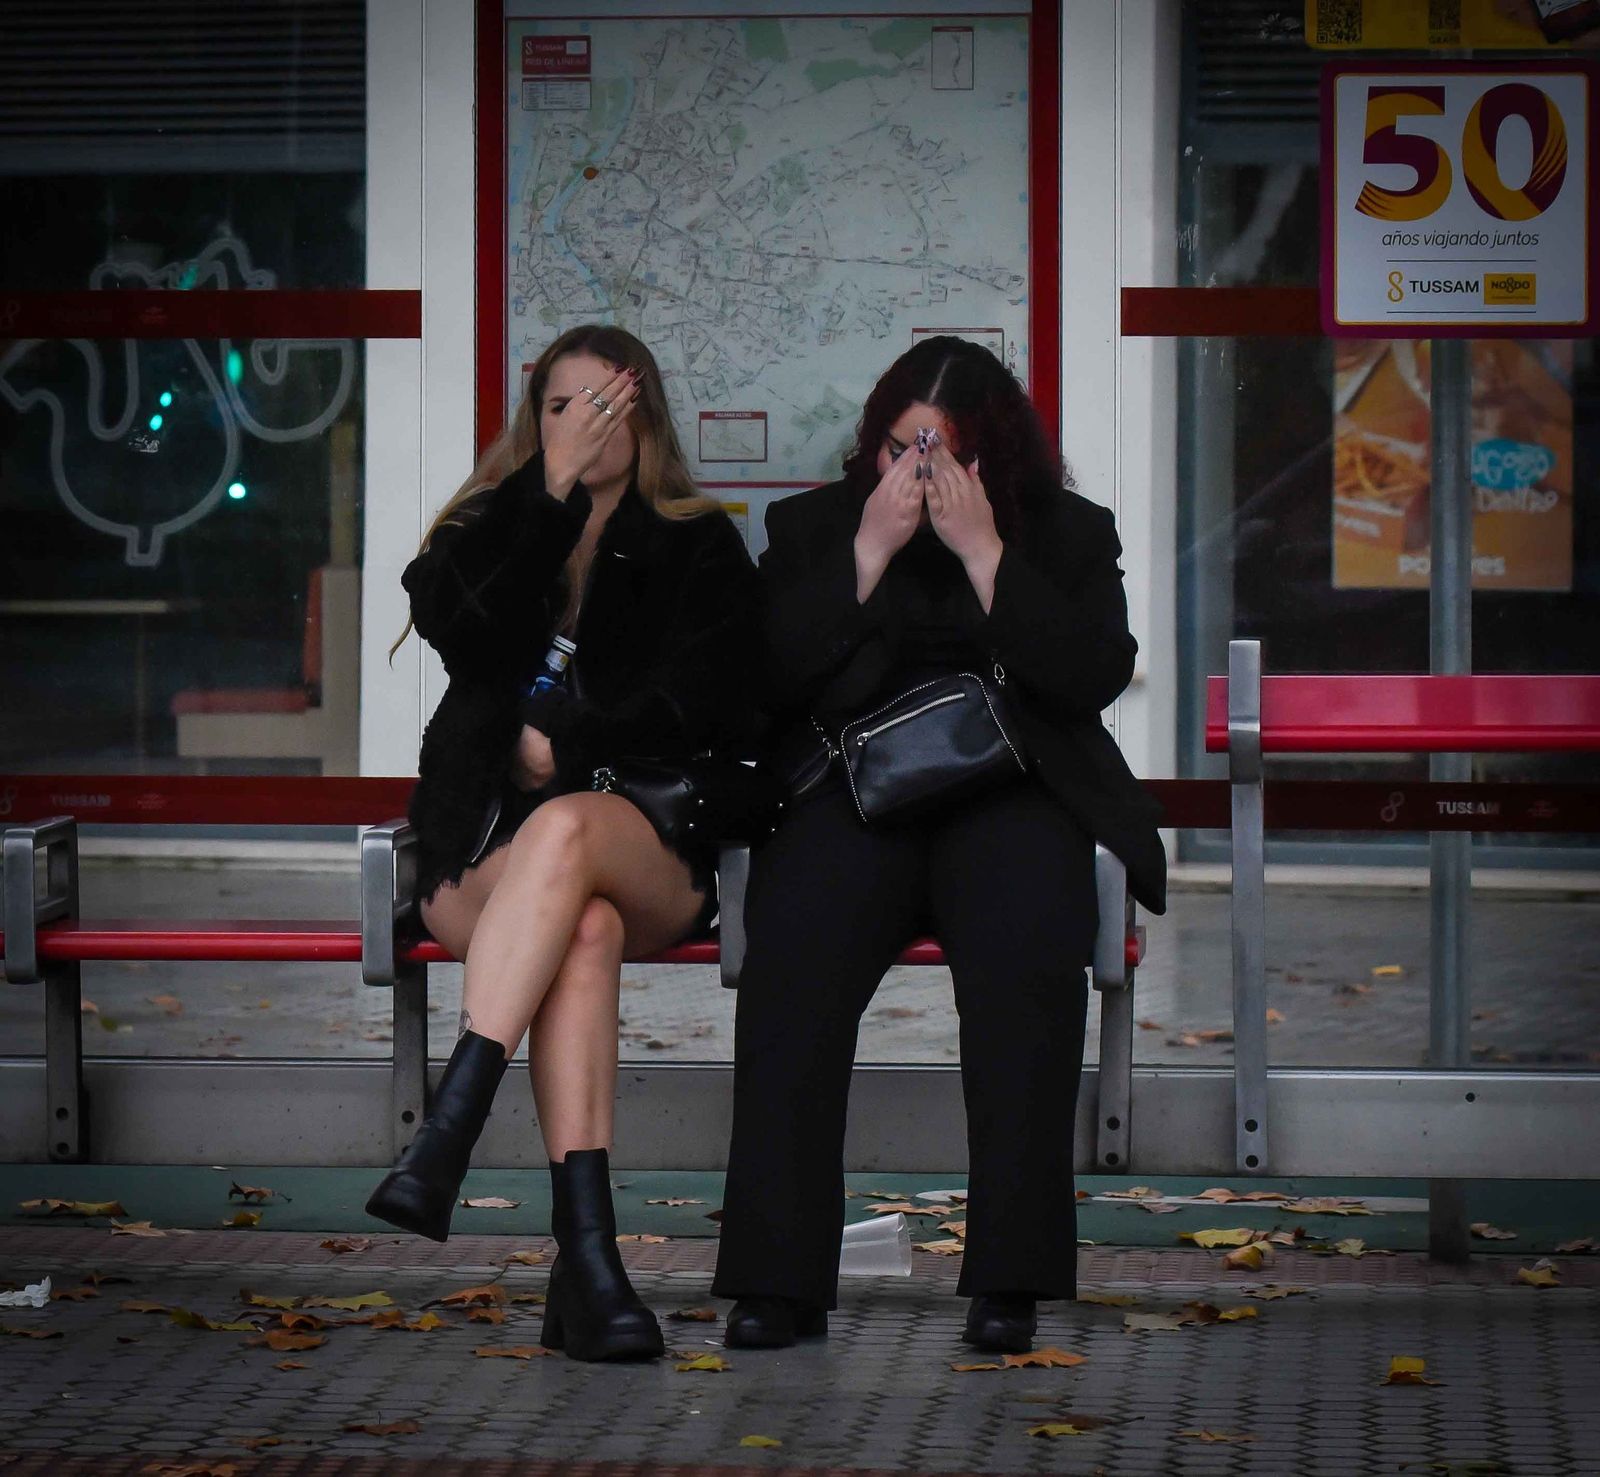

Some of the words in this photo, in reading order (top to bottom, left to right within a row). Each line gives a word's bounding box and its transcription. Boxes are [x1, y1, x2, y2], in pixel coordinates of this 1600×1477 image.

[1355, 83, 1567, 222] 50
[1382, 230, 1420, 246] años
[1424, 230, 1489, 249] viajando
[1490, 230, 1539, 249] juntos
[1409, 280, 1479, 293] TUSSAM
[1436, 801, 1500, 814] TUSSAM
